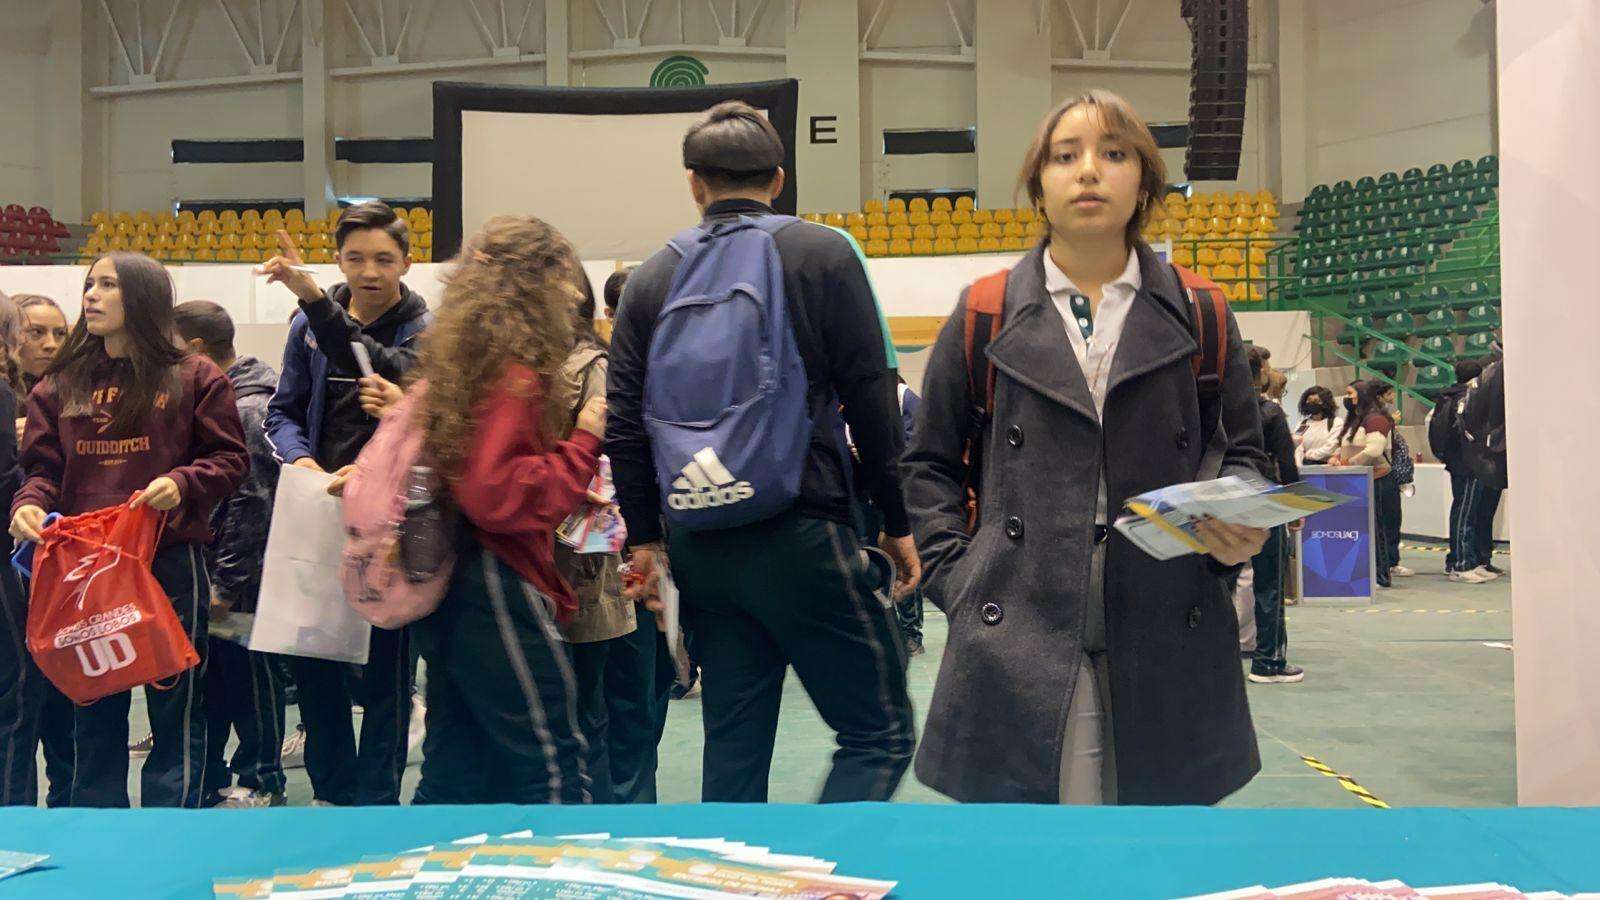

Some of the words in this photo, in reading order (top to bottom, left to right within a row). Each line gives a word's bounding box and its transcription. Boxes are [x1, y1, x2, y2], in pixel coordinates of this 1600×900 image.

[810, 116, 838, 144] E
[76, 436, 151, 456] QUIDDITCH
[667, 481, 755, 510] adidas
[89, 602, 137, 625] GRANDES
[58, 628, 97, 646] SOMOS
[97, 613, 138, 633] LOBOS
[75, 632, 137, 677] UD
